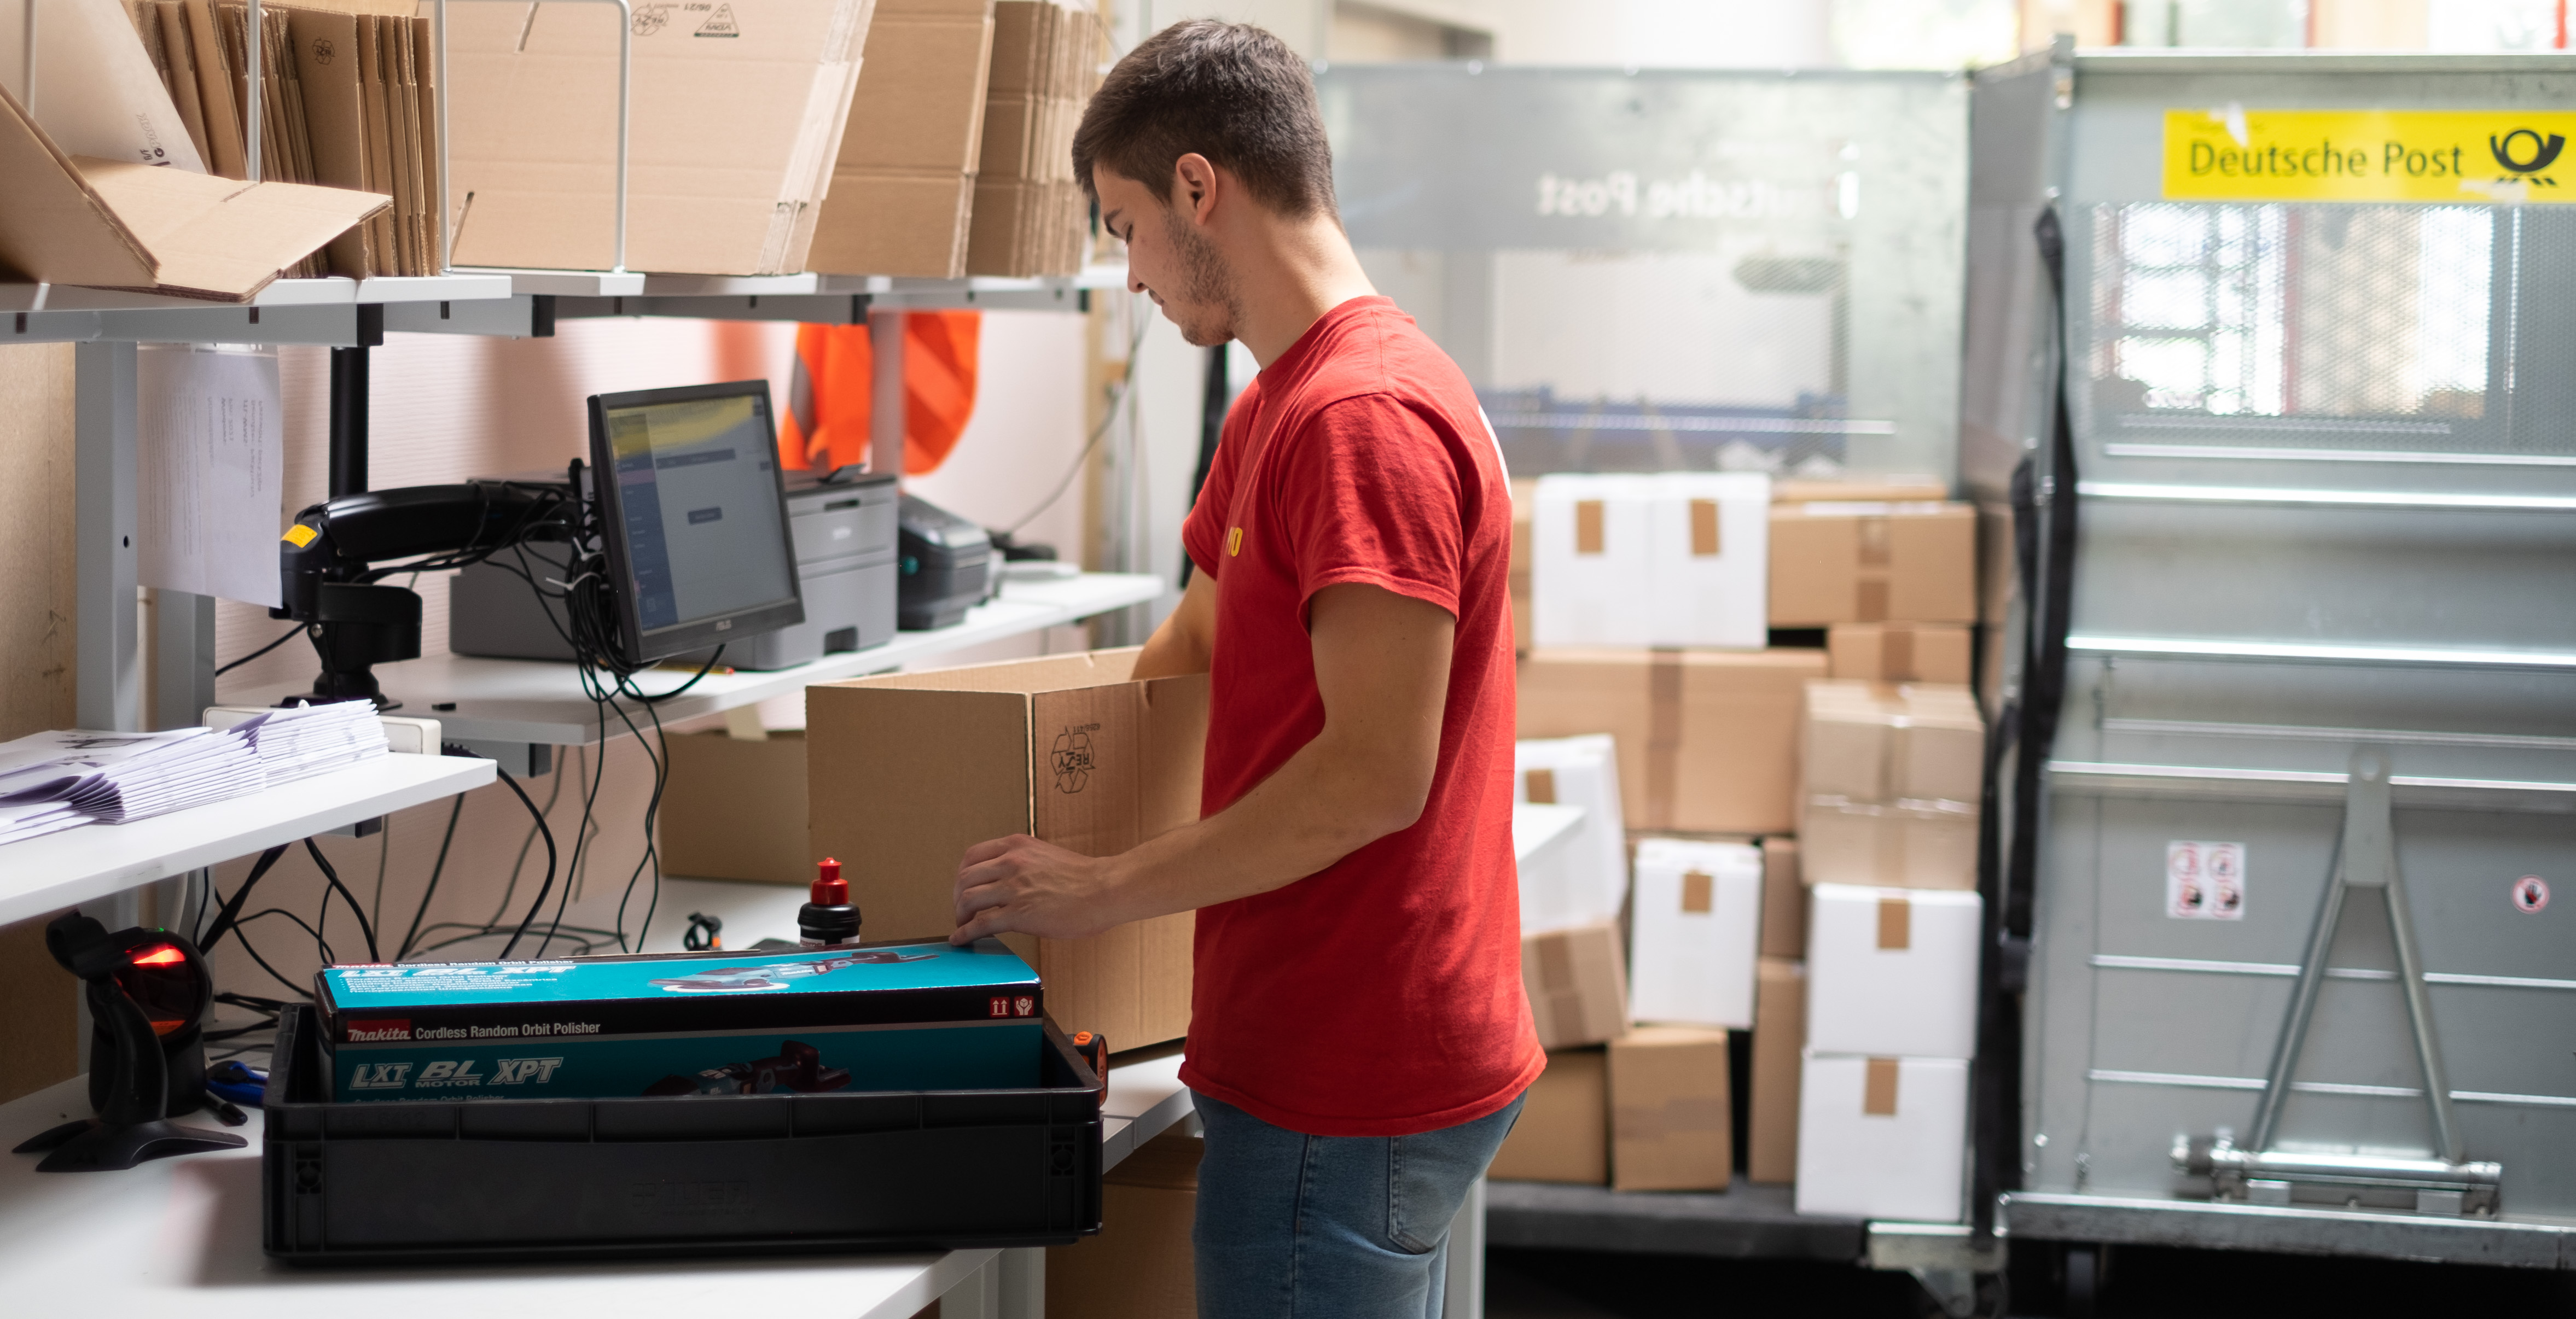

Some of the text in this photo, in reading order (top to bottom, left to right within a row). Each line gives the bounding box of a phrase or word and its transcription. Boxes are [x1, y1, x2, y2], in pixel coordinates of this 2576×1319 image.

[2190, 137, 2464, 177] Deutsche Post
[338, 969, 408, 978] LXT
[493, 965, 577, 974] XPT
[416, 1026, 468, 1039] Cordless
[470, 1025, 519, 1037] Random
[522, 1023, 551, 1036] Orbit
[553, 1021, 601, 1035] Polisher
[348, 1057, 564, 1090] LXT BL XPT
[415, 1078, 481, 1088] MOTOR
